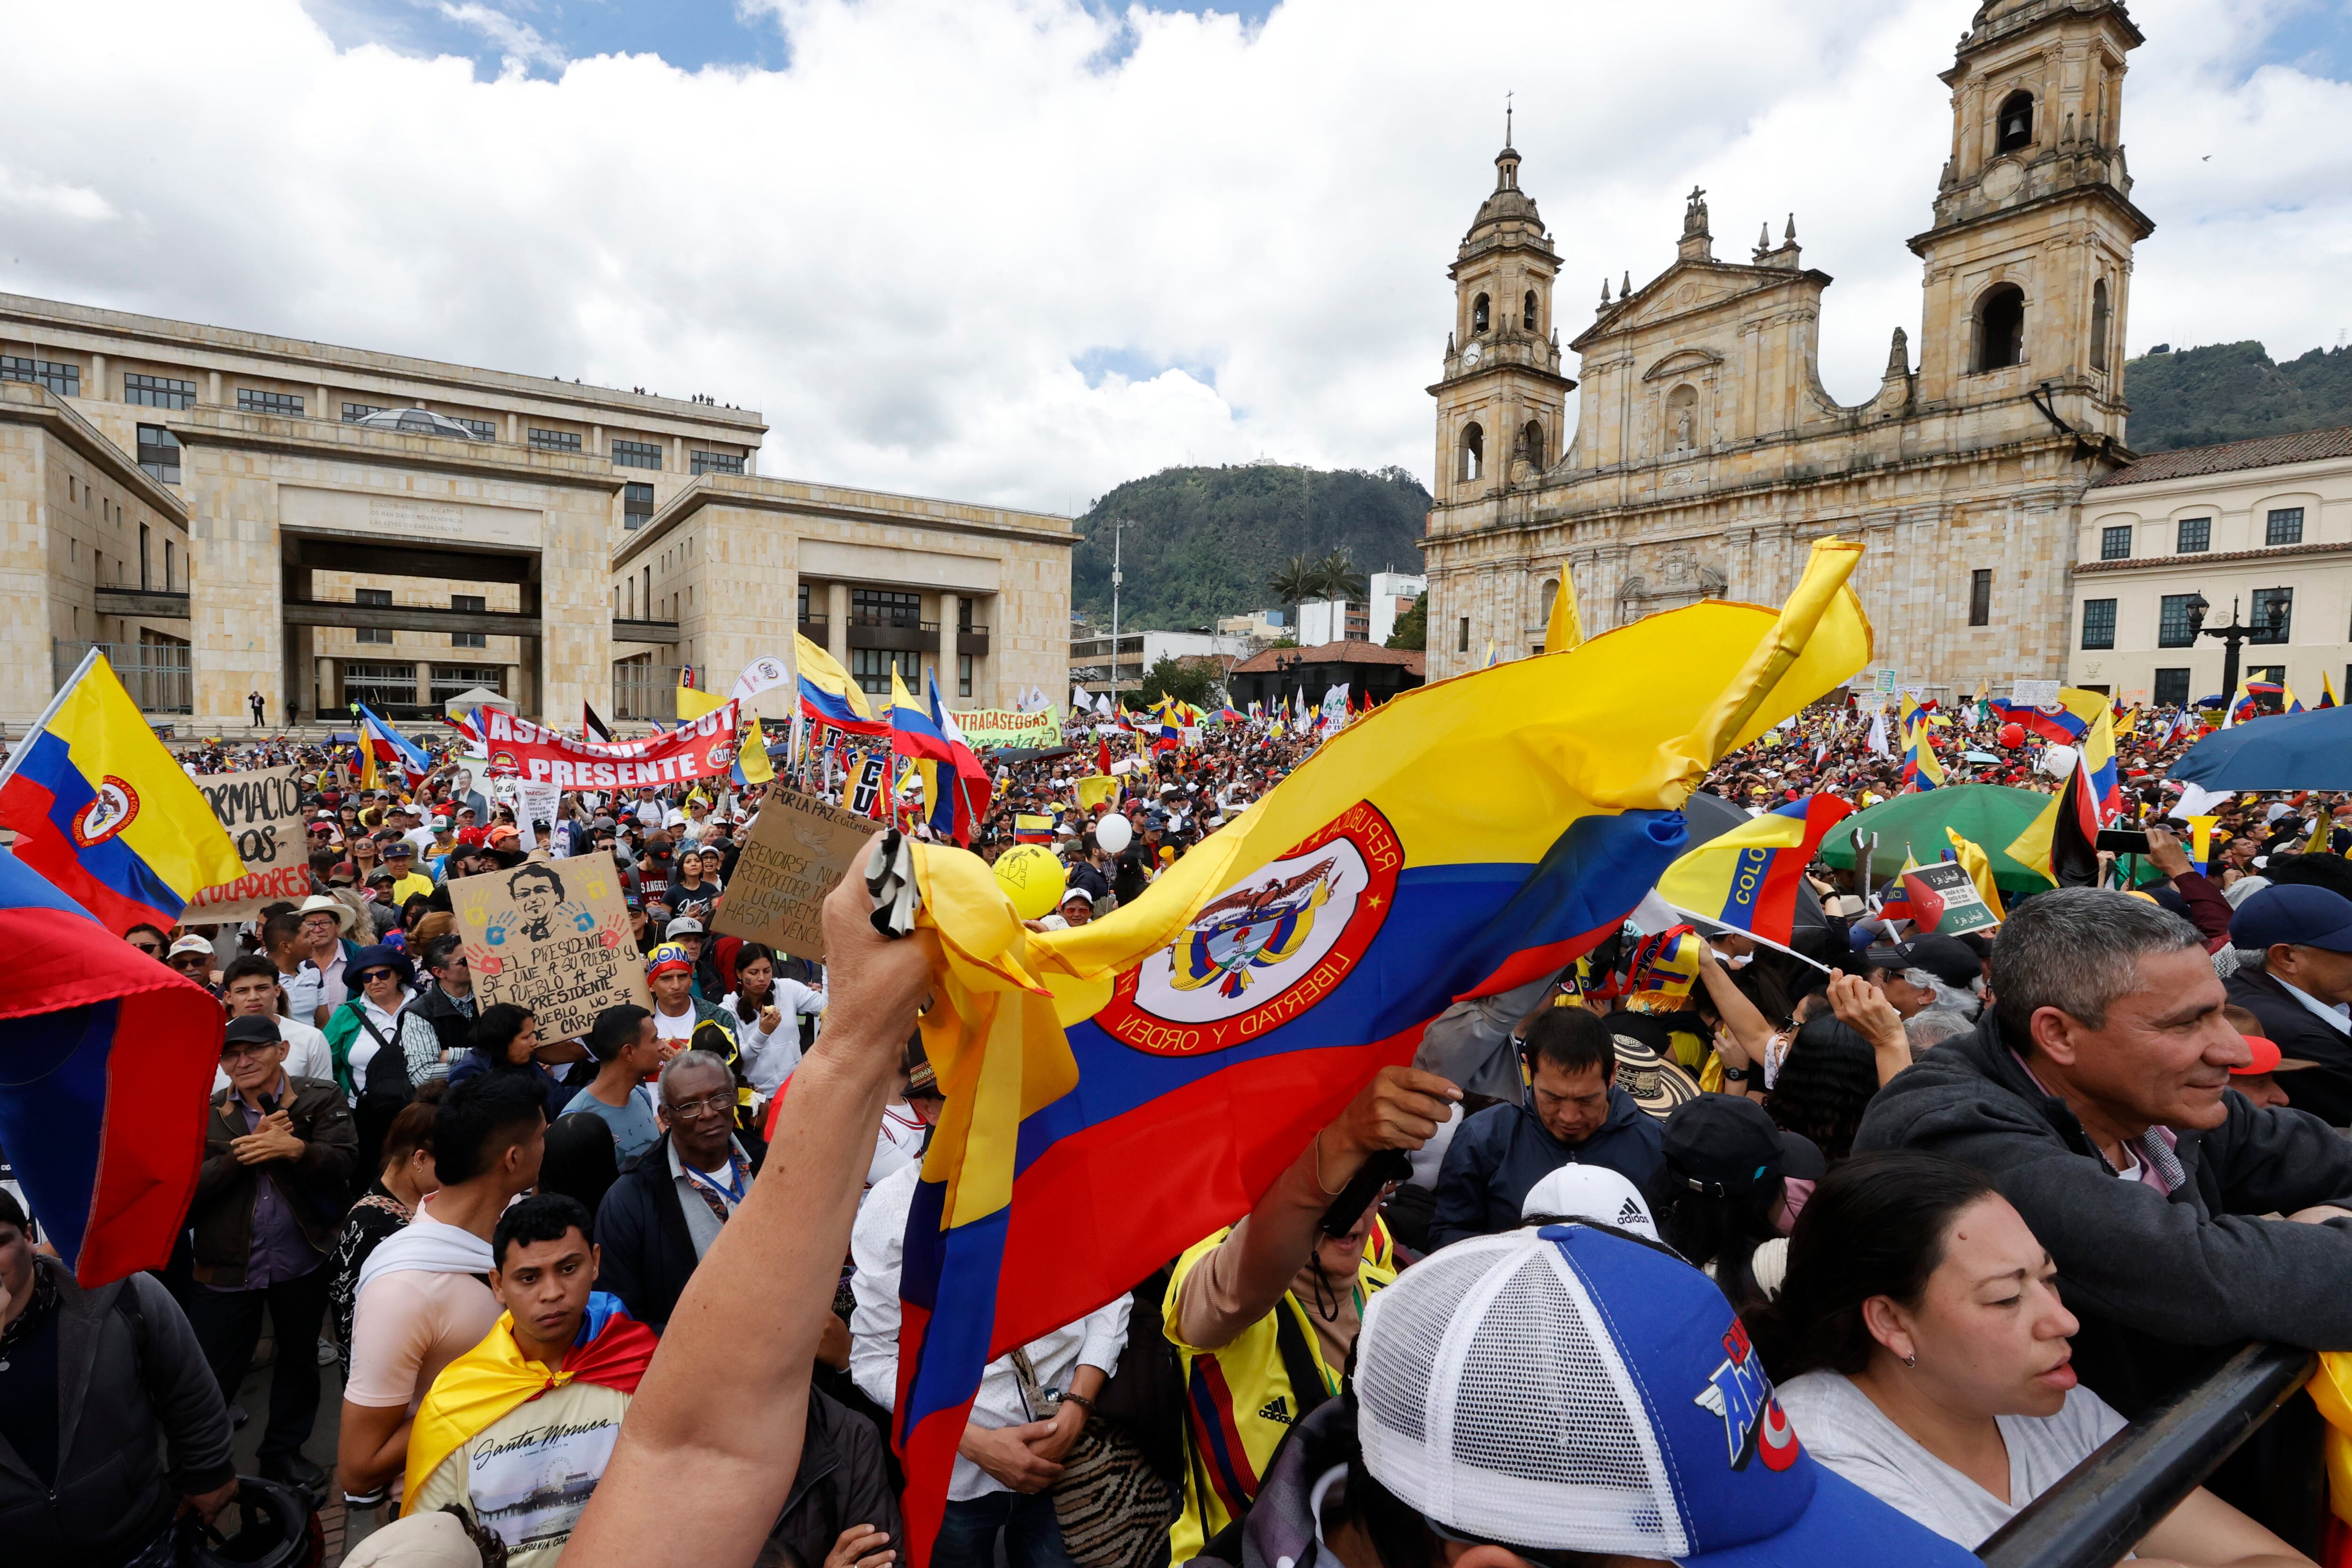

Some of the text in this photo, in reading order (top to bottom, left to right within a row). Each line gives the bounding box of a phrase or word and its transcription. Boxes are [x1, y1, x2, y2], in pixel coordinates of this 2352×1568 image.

[676, 704, 735, 742] CUT
[528, 752, 698, 786] PRESENTE
[124, 788, 135, 796] DE
[771, 787, 795, 808] POR
[795, 799, 809, 813] LA
[812, 801, 836, 821] PAZ
[848, 813, 857, 822] DE
[116, 801, 138, 830] COLOMBIA
[745, 841, 813, 877] RENDIRSE
[737, 860, 810, 899] RETROCEDER
[723, 901, 771, 930] HASTA
[483, 974, 504, 993] SE
[513, 967, 540, 983] UNE
[548, 962, 557, 976] A
[563, 957, 577, 972] SU
[581, 947, 620, 967] PUEBLO
[501, 931, 607, 974] EL PRESIDENTE
[509, 976, 564, 1001] PUEBLO
[574, 969, 586, 985] A
[596, 966, 617, 978] SU
[528, 977, 613, 1011] PRESIDENTE
[533, 988, 632, 1027] PUEBLO NO SE
[1617, 1213, 1649, 1224] adidas
[1259, 1409, 1292, 1425] adidas
[473, 1418, 611, 1470] Santa Monica
[508, 1540, 549, 1556] CALIFORNIA
